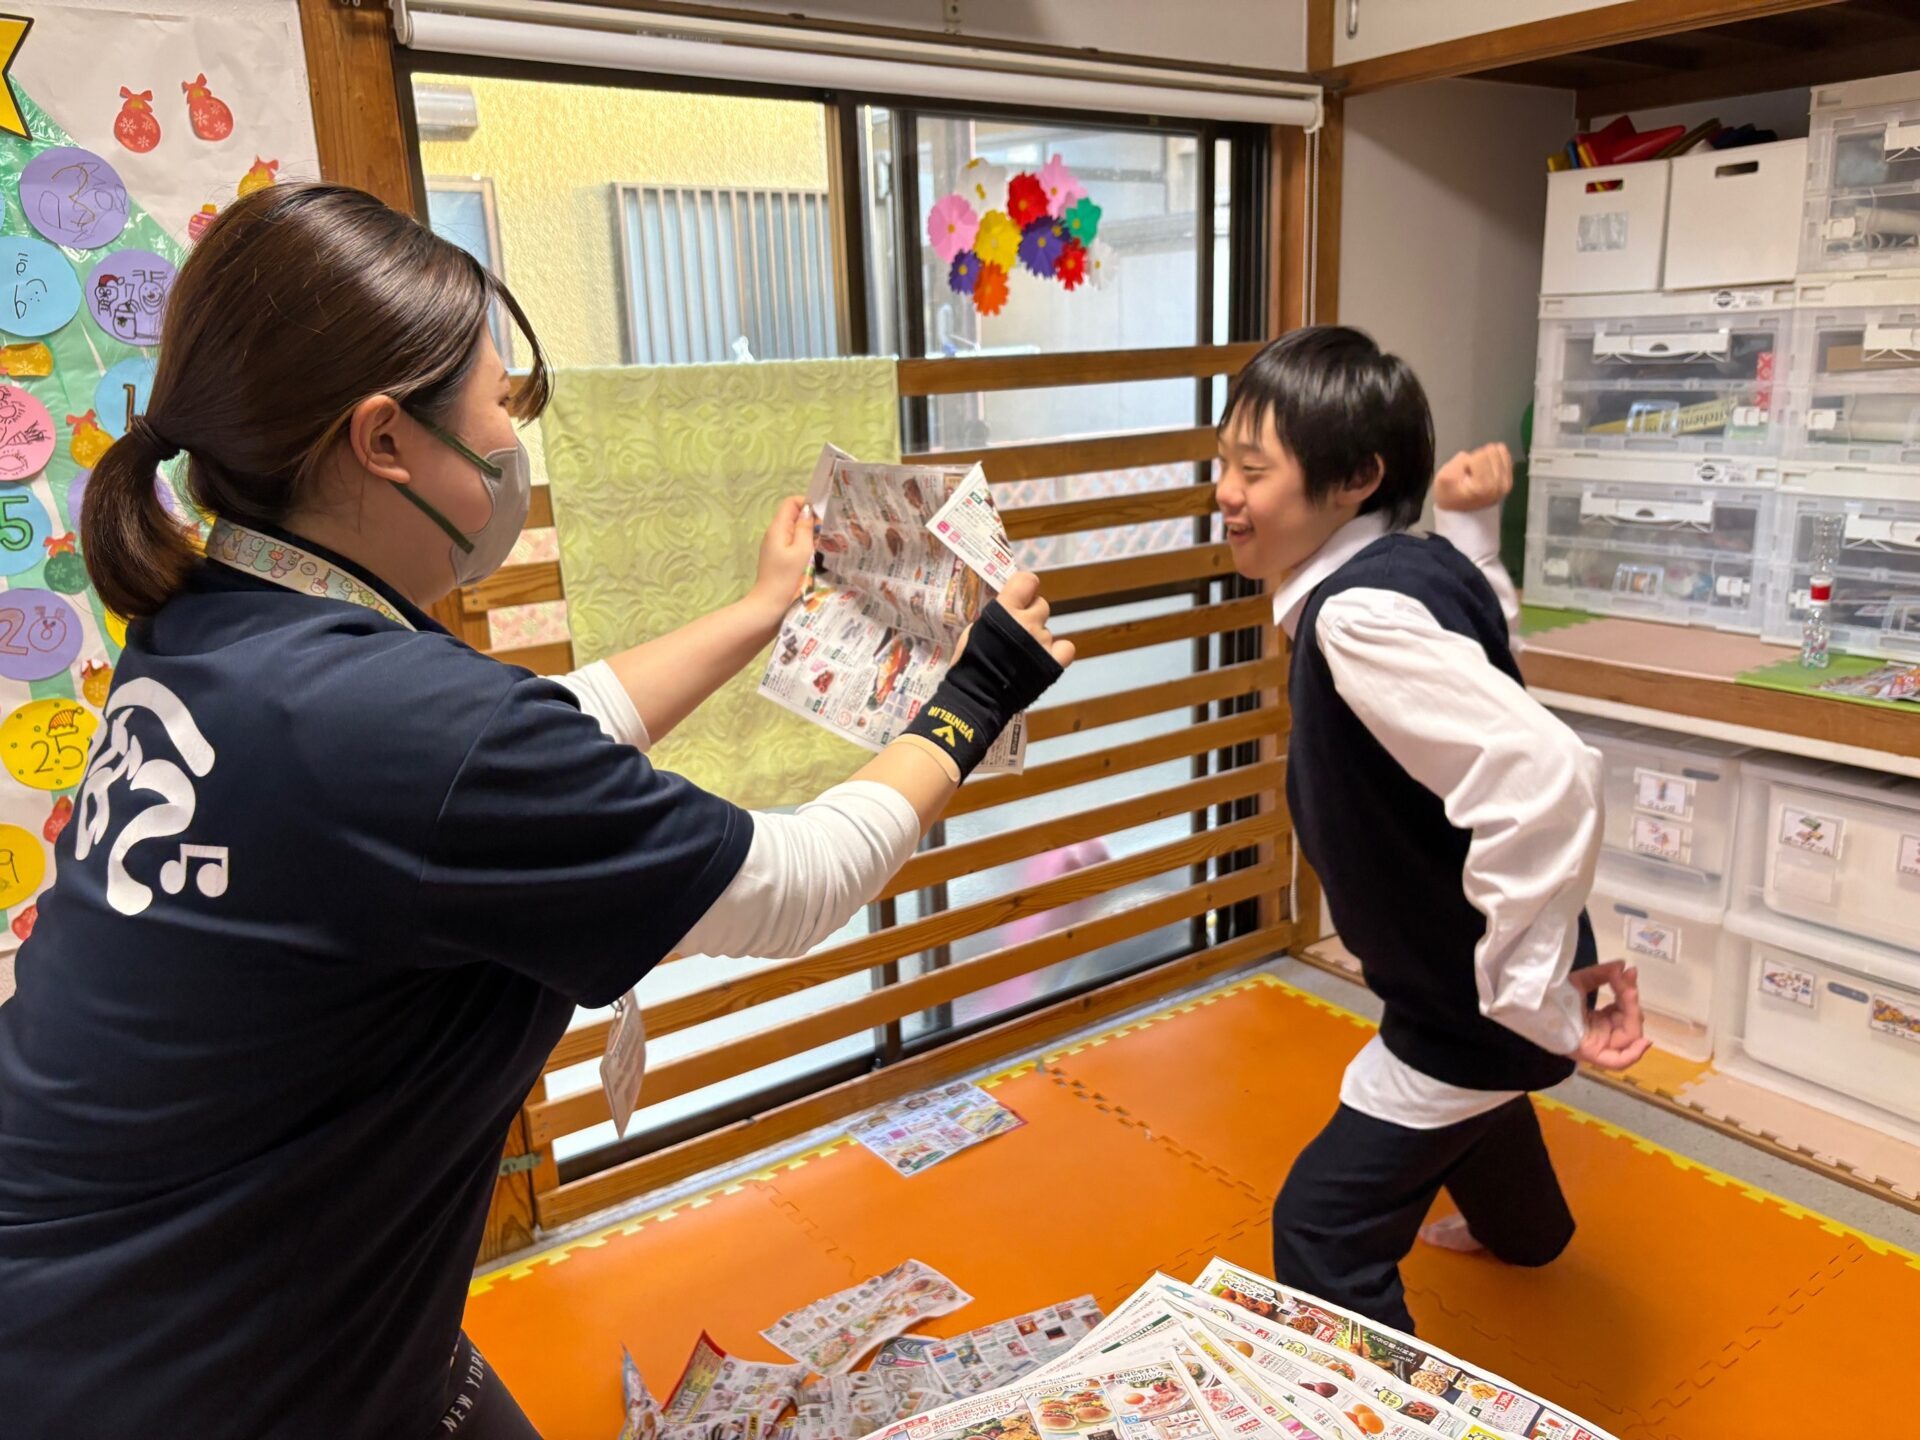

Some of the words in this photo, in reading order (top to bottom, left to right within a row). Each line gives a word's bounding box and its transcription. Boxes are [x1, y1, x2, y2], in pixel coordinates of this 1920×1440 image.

[927, 705, 974, 743] VANTELIN
[30, 732, 84, 774] 25
[441, 1393, 474, 1433] NEW
